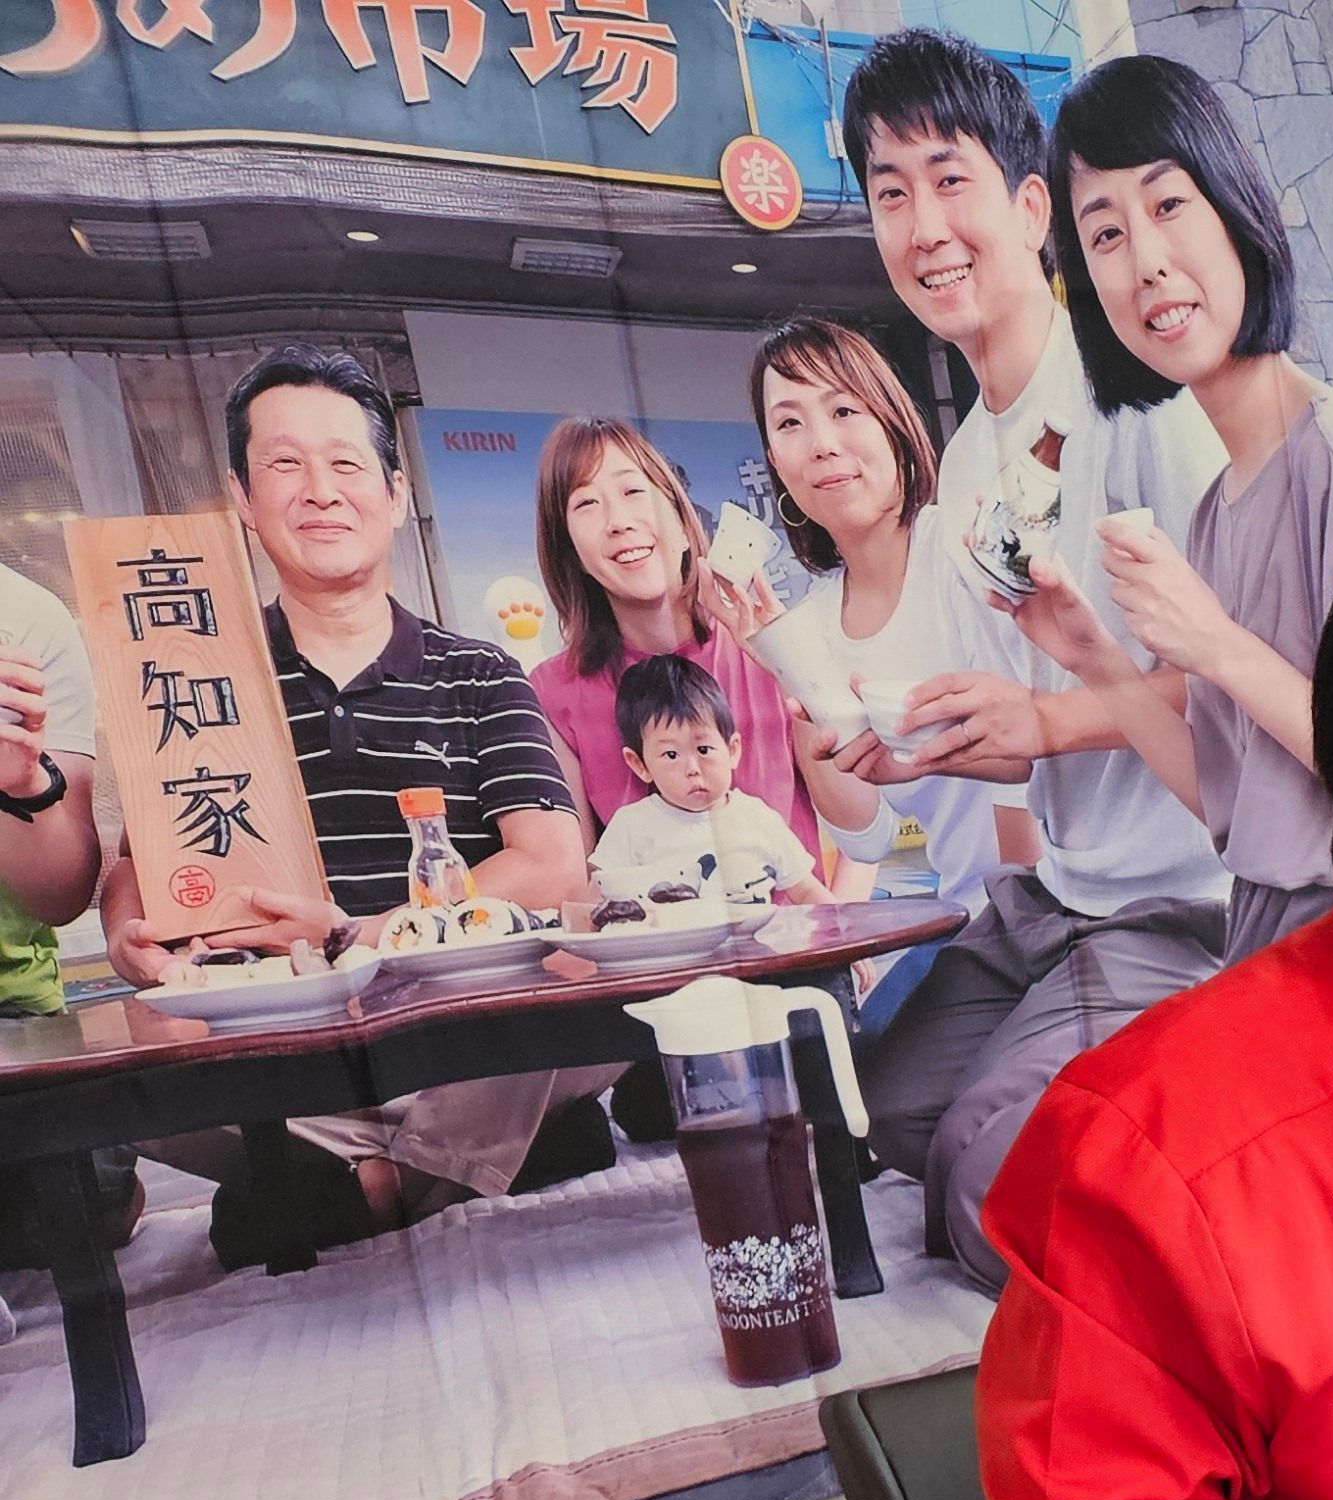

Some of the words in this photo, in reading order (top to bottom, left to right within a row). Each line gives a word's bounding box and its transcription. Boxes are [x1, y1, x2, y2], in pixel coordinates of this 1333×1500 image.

[740, 151, 786, 214] 楽
[443, 431, 517, 454] KIRIN
[116, 549, 268, 859] 高知家
